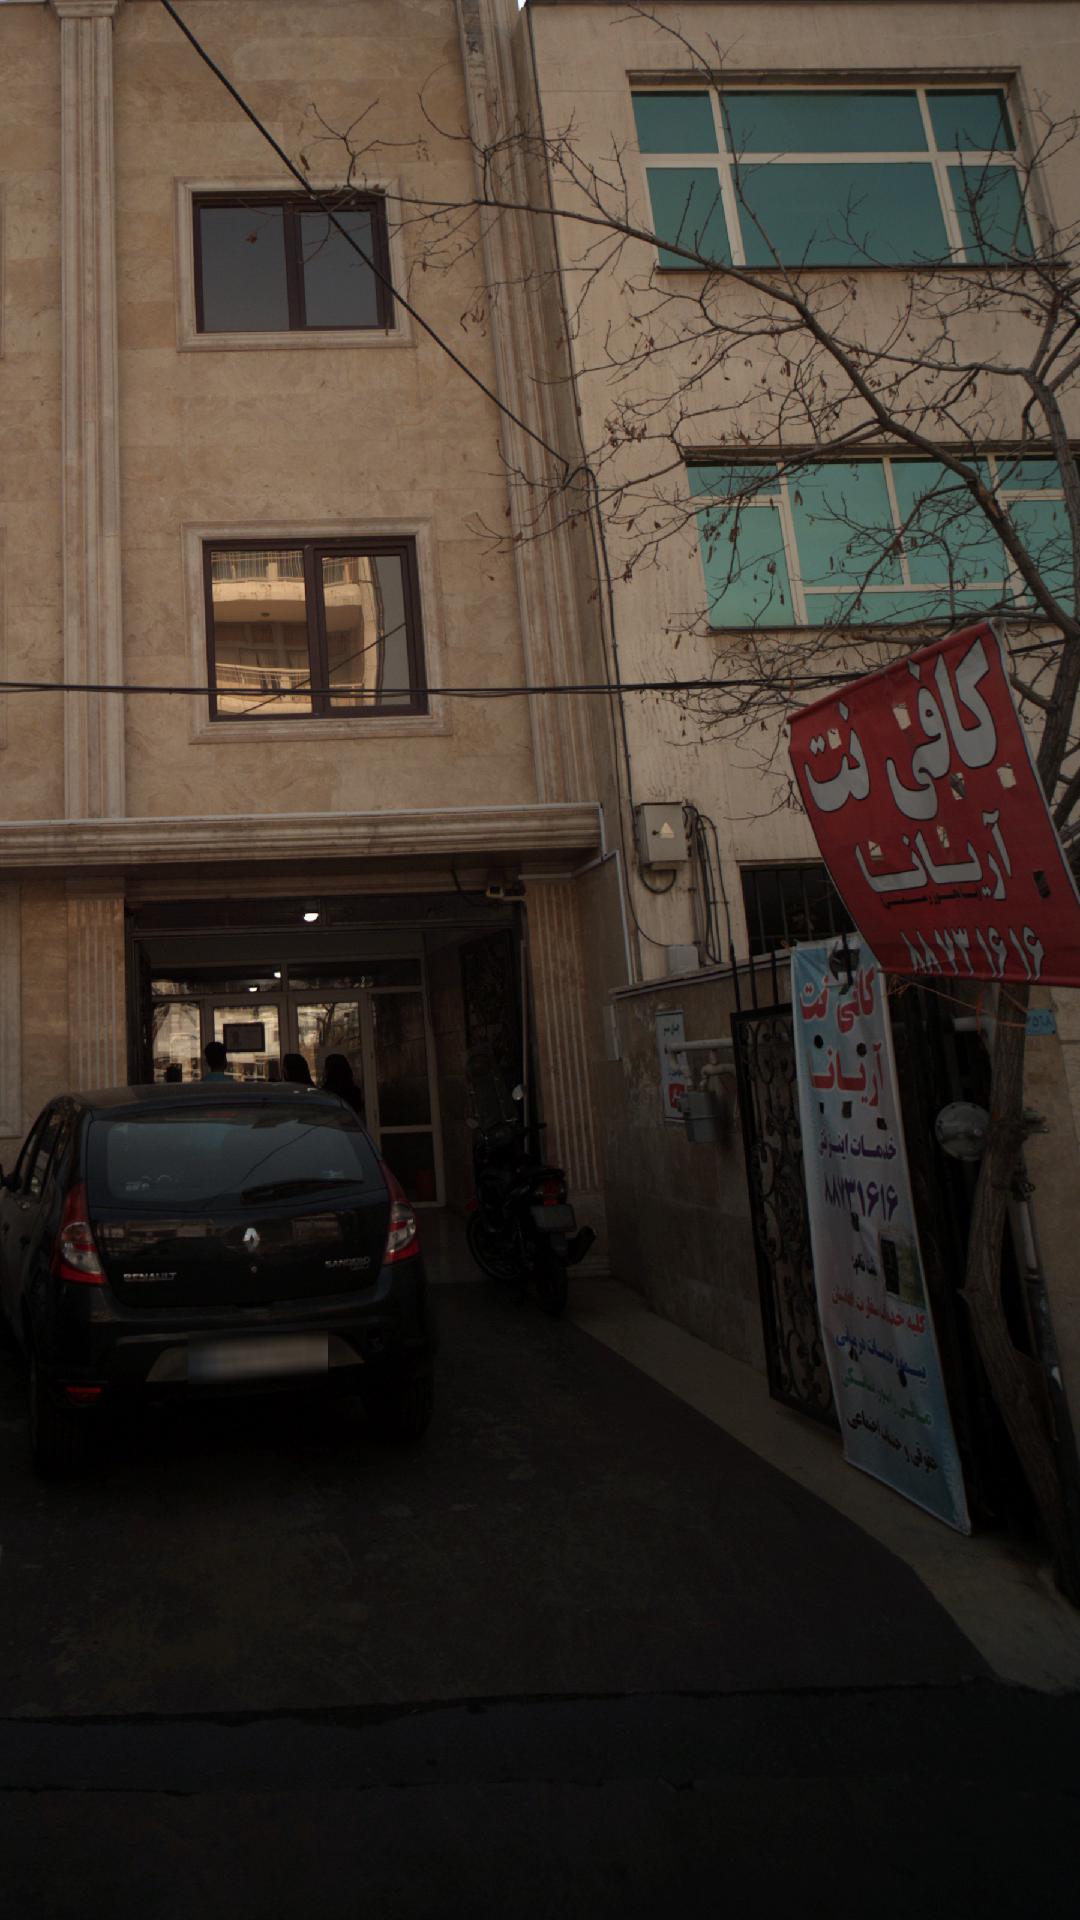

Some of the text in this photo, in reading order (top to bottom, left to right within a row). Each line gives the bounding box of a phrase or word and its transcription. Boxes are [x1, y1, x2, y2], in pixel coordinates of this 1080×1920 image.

[803, 637, 998, 821] کافی نت
[855, 809, 1012, 901] آریانا
[900, 926, 1045, 982] ۸۸۷۳۱۶۱۶
[800, 974, 830, 1021] نت
[824, 1172, 899, 1222] ۸۸۷۳۱۶۱۶
[123, 1271, 177, 1282] RENAULT
